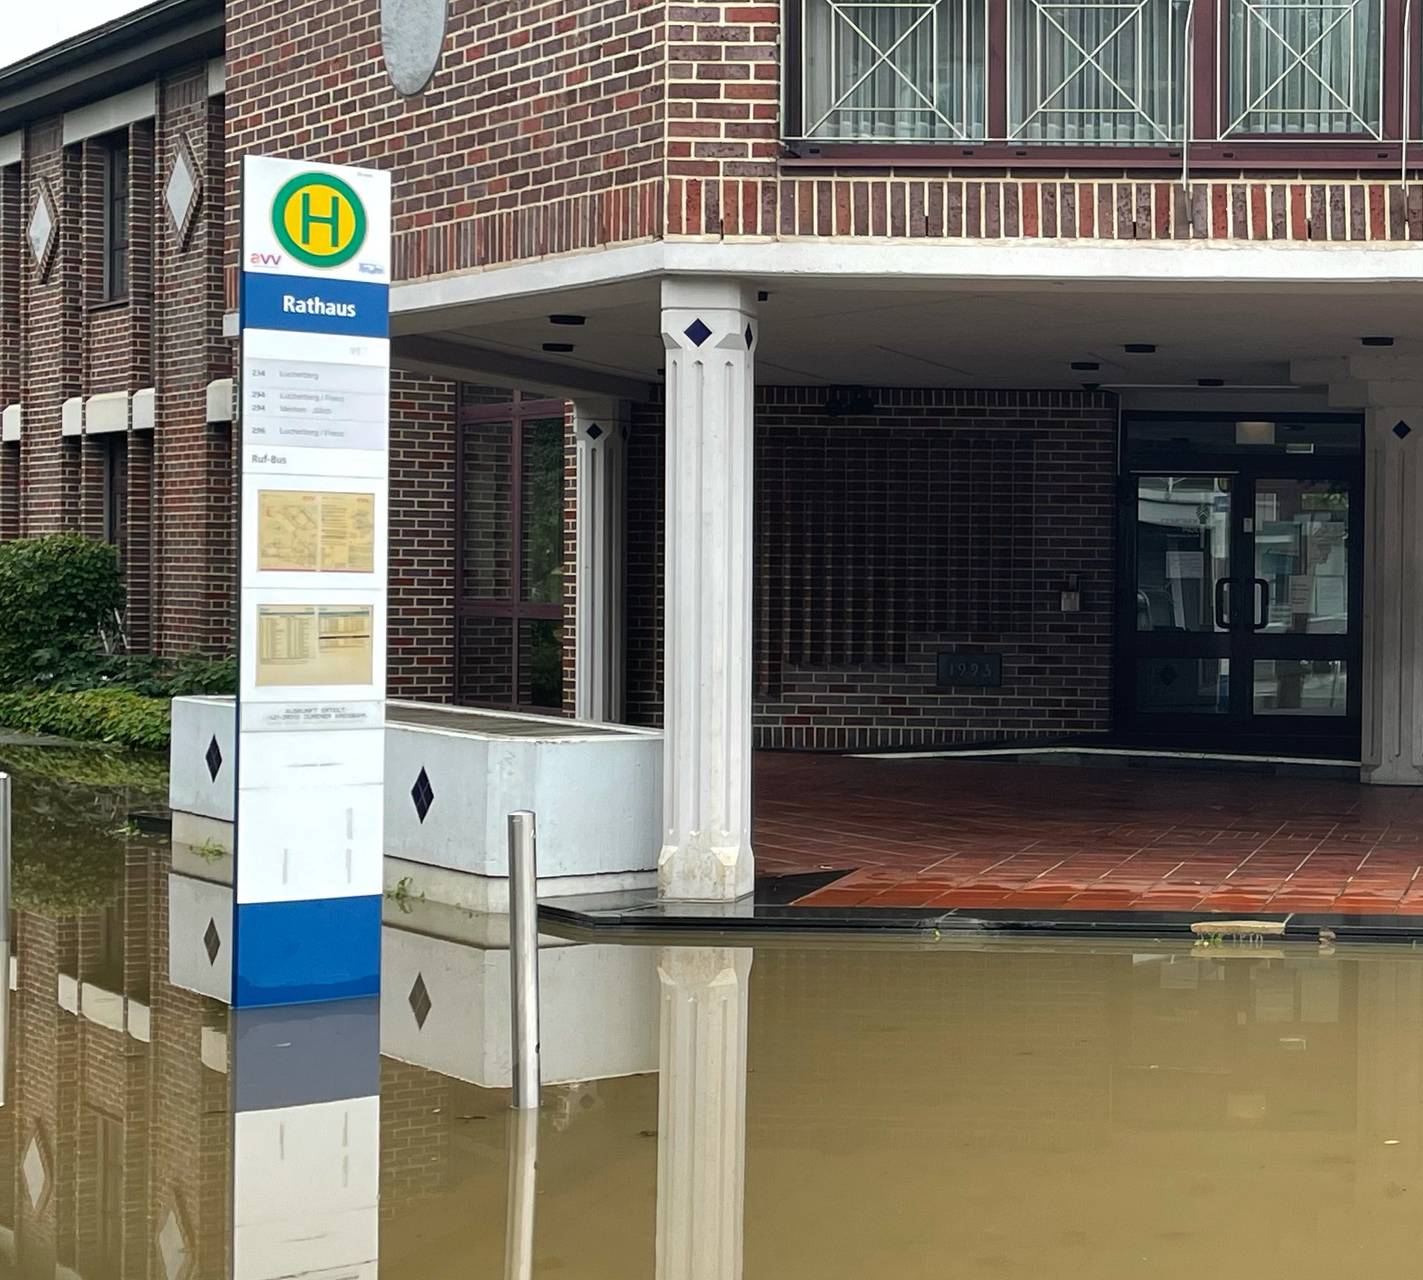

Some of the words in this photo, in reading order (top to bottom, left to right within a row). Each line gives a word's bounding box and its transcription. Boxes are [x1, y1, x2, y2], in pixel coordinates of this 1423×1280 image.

[302, 192, 339, 247] H
[282, 295, 357, 318] Rathaus
[251, 454, 287, 465] Ruf-Bus
